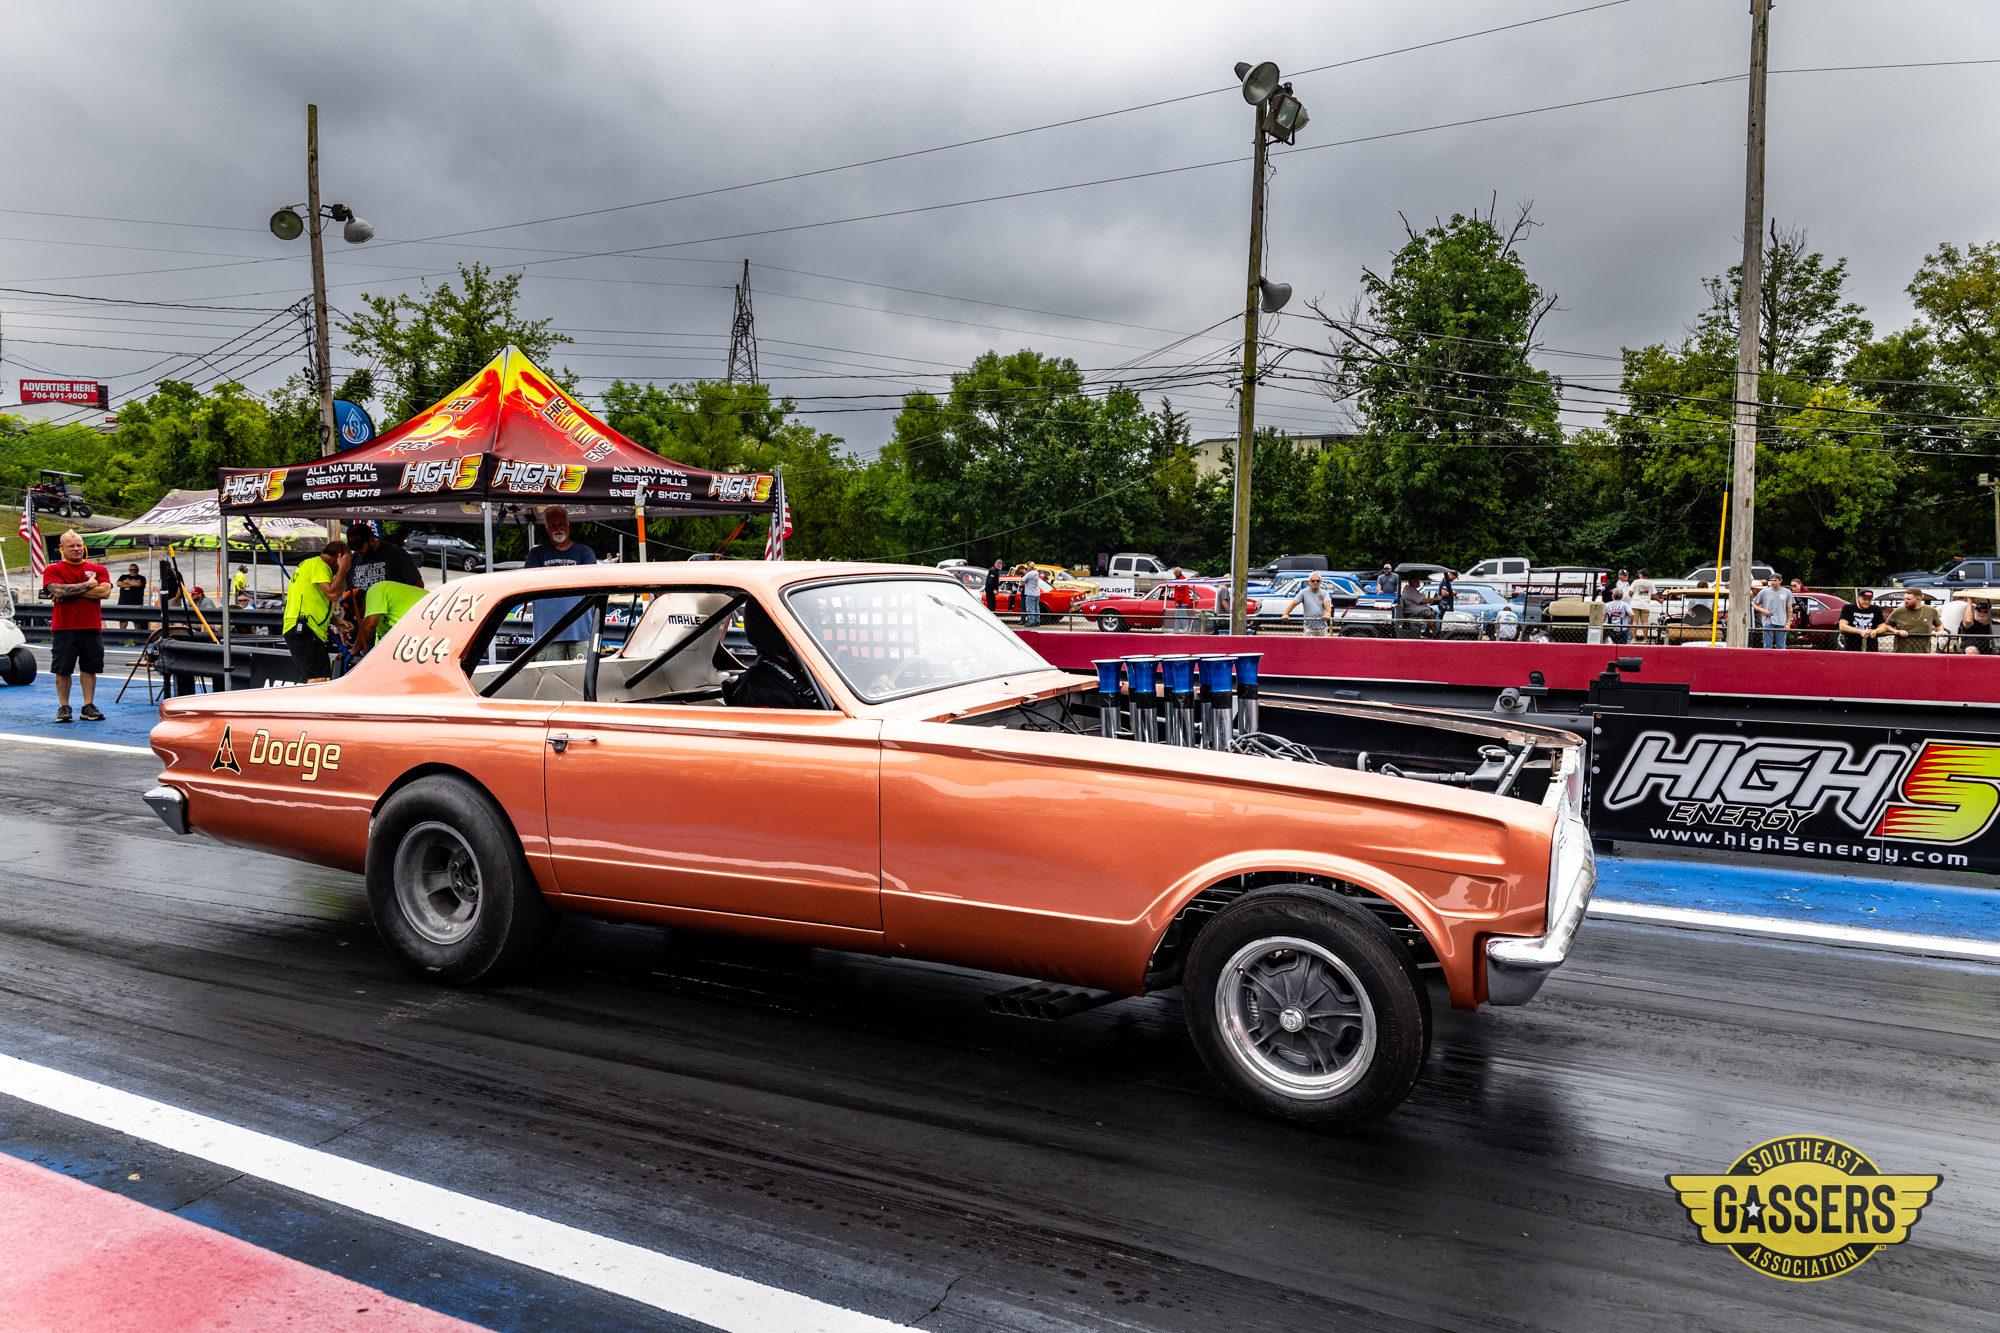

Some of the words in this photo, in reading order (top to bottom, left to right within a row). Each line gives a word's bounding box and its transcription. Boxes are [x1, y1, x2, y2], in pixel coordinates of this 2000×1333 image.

[22, 382, 71, 392] ADVERTISE
[73, 383, 97, 393] HERE
[31, 391, 88, 400] 706-891-9000
[307, 466, 326, 476] ALL
[329, 463, 377, 474] NATURAL
[400, 458, 460, 491] HIGH
[450, 453, 483, 490] 5
[492, 459, 562, 491] HIGH
[556, 463, 588, 493] 5
[637, 466, 687, 477] NATURAL
[221, 474, 269, 502] HIGH
[263, 469, 289, 501] 5
[306, 474, 347, 486] ENERGY
[350, 473, 378, 483] PILLS
[612, 474, 657, 484] ENERGY
[660, 477, 688, 487] PILLS
[411, 482, 441, 492] ENERGY
[510, 482, 544, 492] ENERGY
[708, 475, 754, 497] HIGH
[752, 475, 774, 502] 5
[232, 494, 256, 503] ENERGY
[302, 489, 343, 501] ENERGY
[346, 488, 382, 499] SHOTS
[609, 488, 654, 498] ENERY
[658, 491, 692, 500] SHOTS
[719, 493, 746, 501] ENERGY
[354, 568, 386, 579] 3PEDALS
[421, 586, 487, 630] A/FX
[668, 614, 701, 625] MAHLE
[392, 634, 451, 665] 1864
[249, 728, 341, 782] Dodge
[1606, 733, 1908, 827] HIGH
[1864, 738, 2000, 845] 5
[1667, 801, 1815, 834] ENERGY
[1649, 827, 1969, 867] www.high5energy.com
